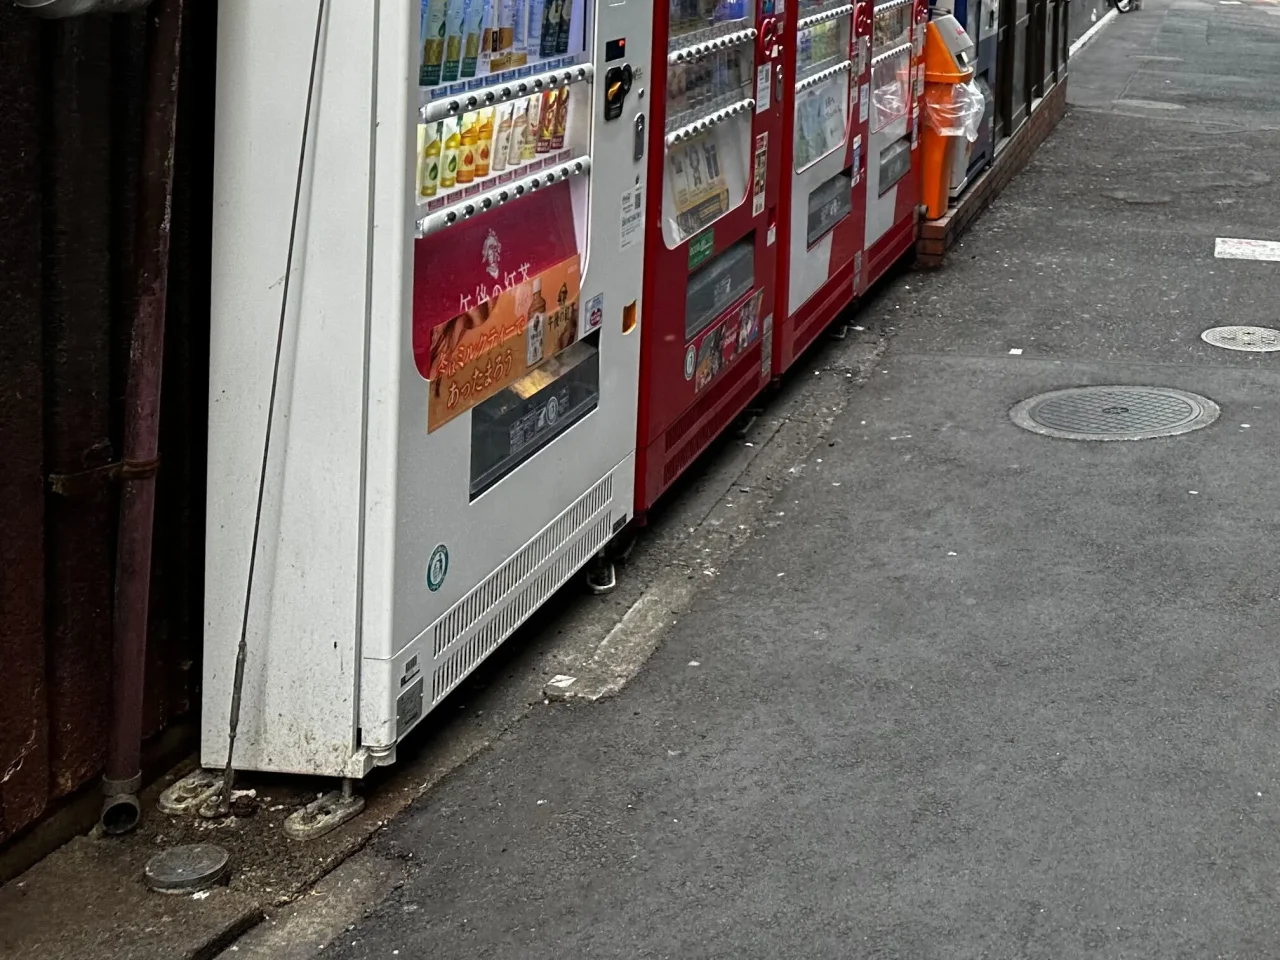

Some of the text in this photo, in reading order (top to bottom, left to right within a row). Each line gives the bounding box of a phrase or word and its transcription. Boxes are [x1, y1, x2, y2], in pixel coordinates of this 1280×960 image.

[447, 348, 513, 409] あったまろう
